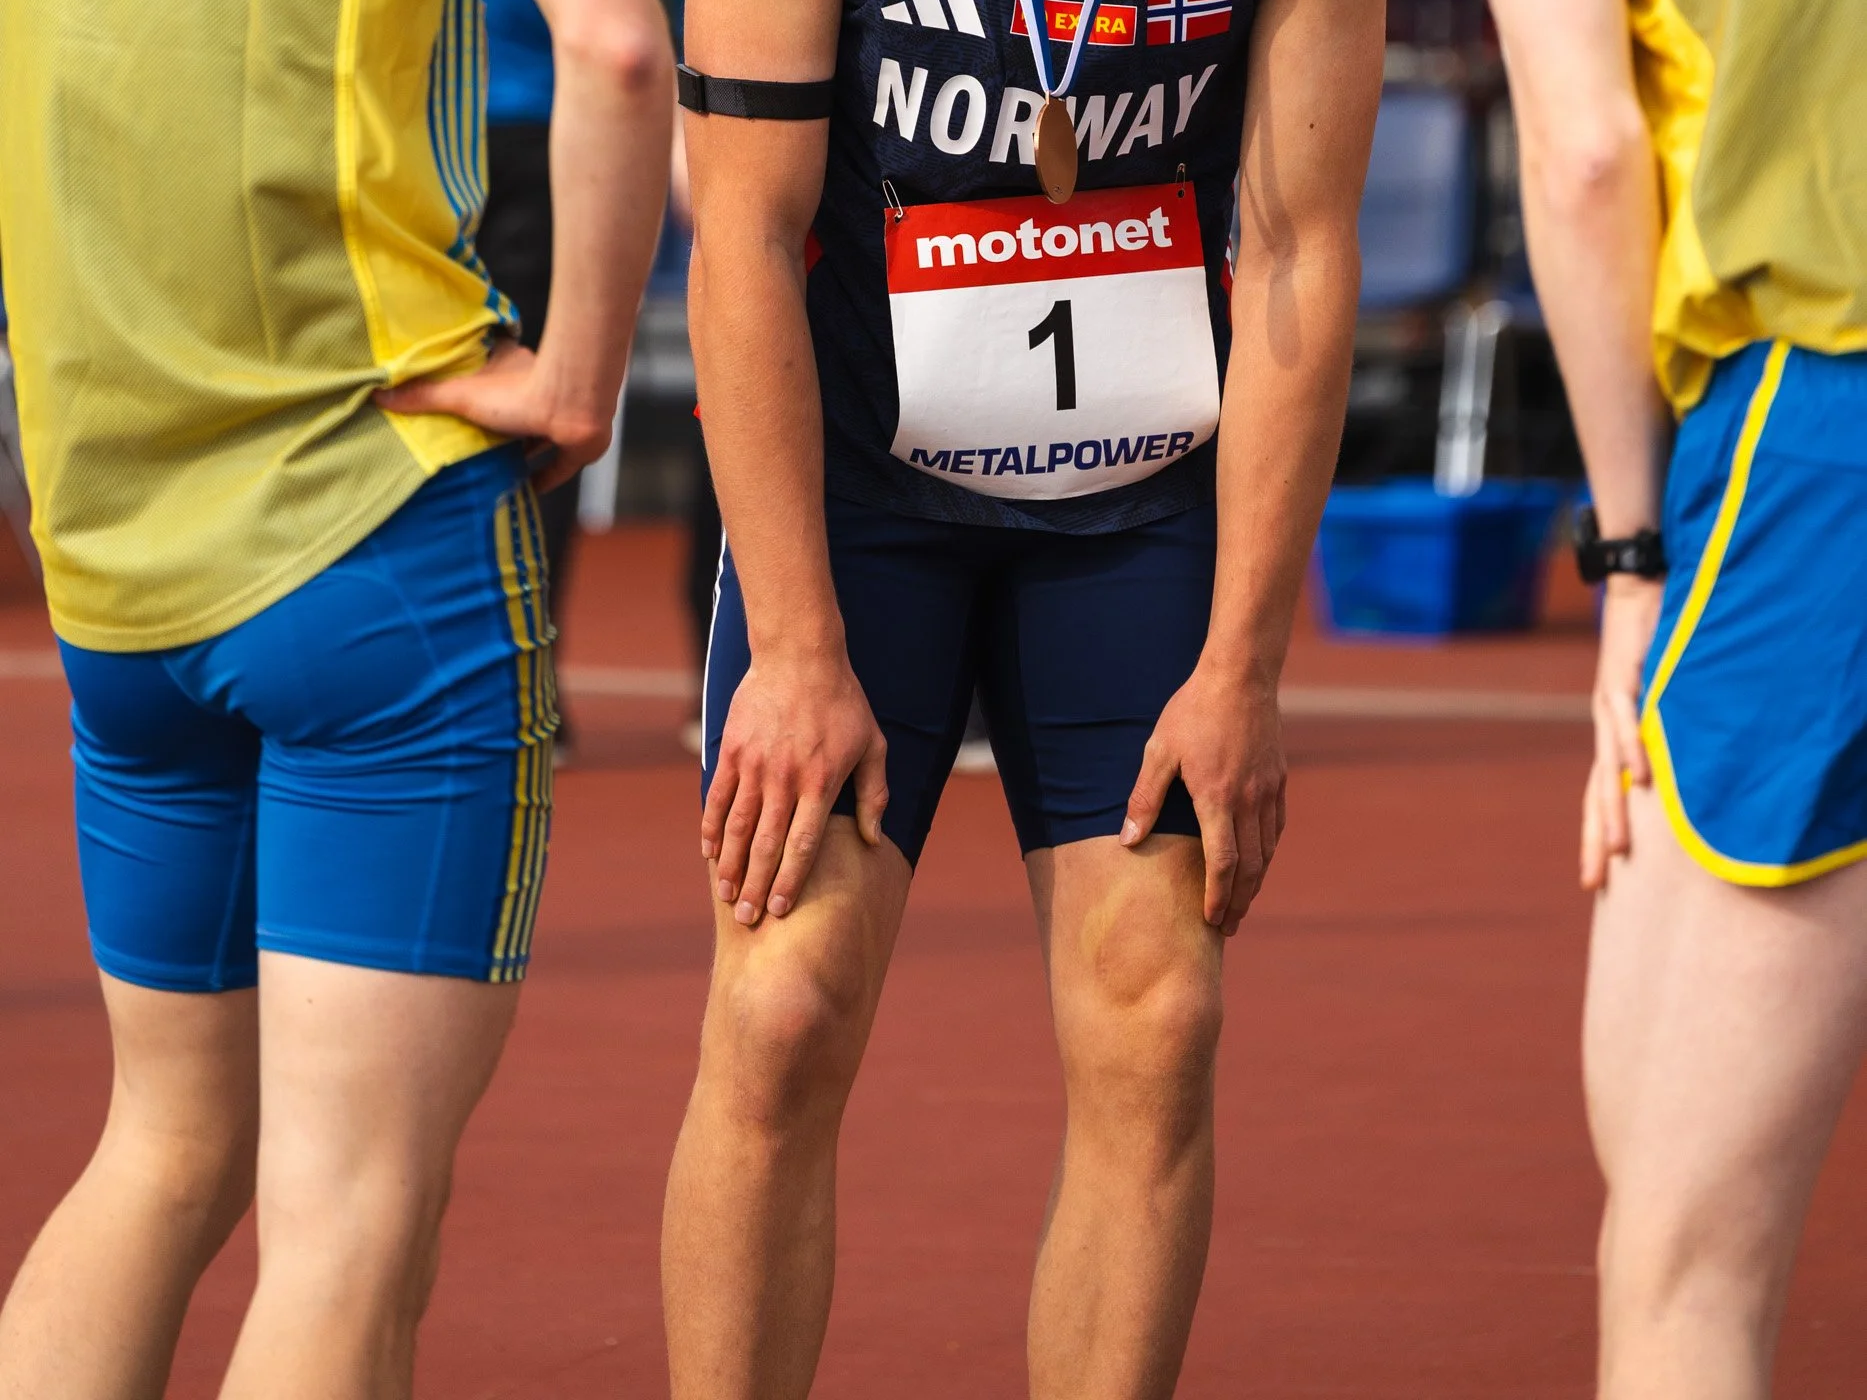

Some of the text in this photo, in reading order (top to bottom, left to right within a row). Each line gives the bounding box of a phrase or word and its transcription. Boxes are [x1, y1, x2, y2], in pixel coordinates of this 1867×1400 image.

[1055, 12, 1127, 34] EXRA
[873, 57, 1219, 166] NORWAY
[916, 206, 1173, 269] motonet
[1028, 299, 1077, 411] 1
[909, 431, 1195, 476] METALPOWER
